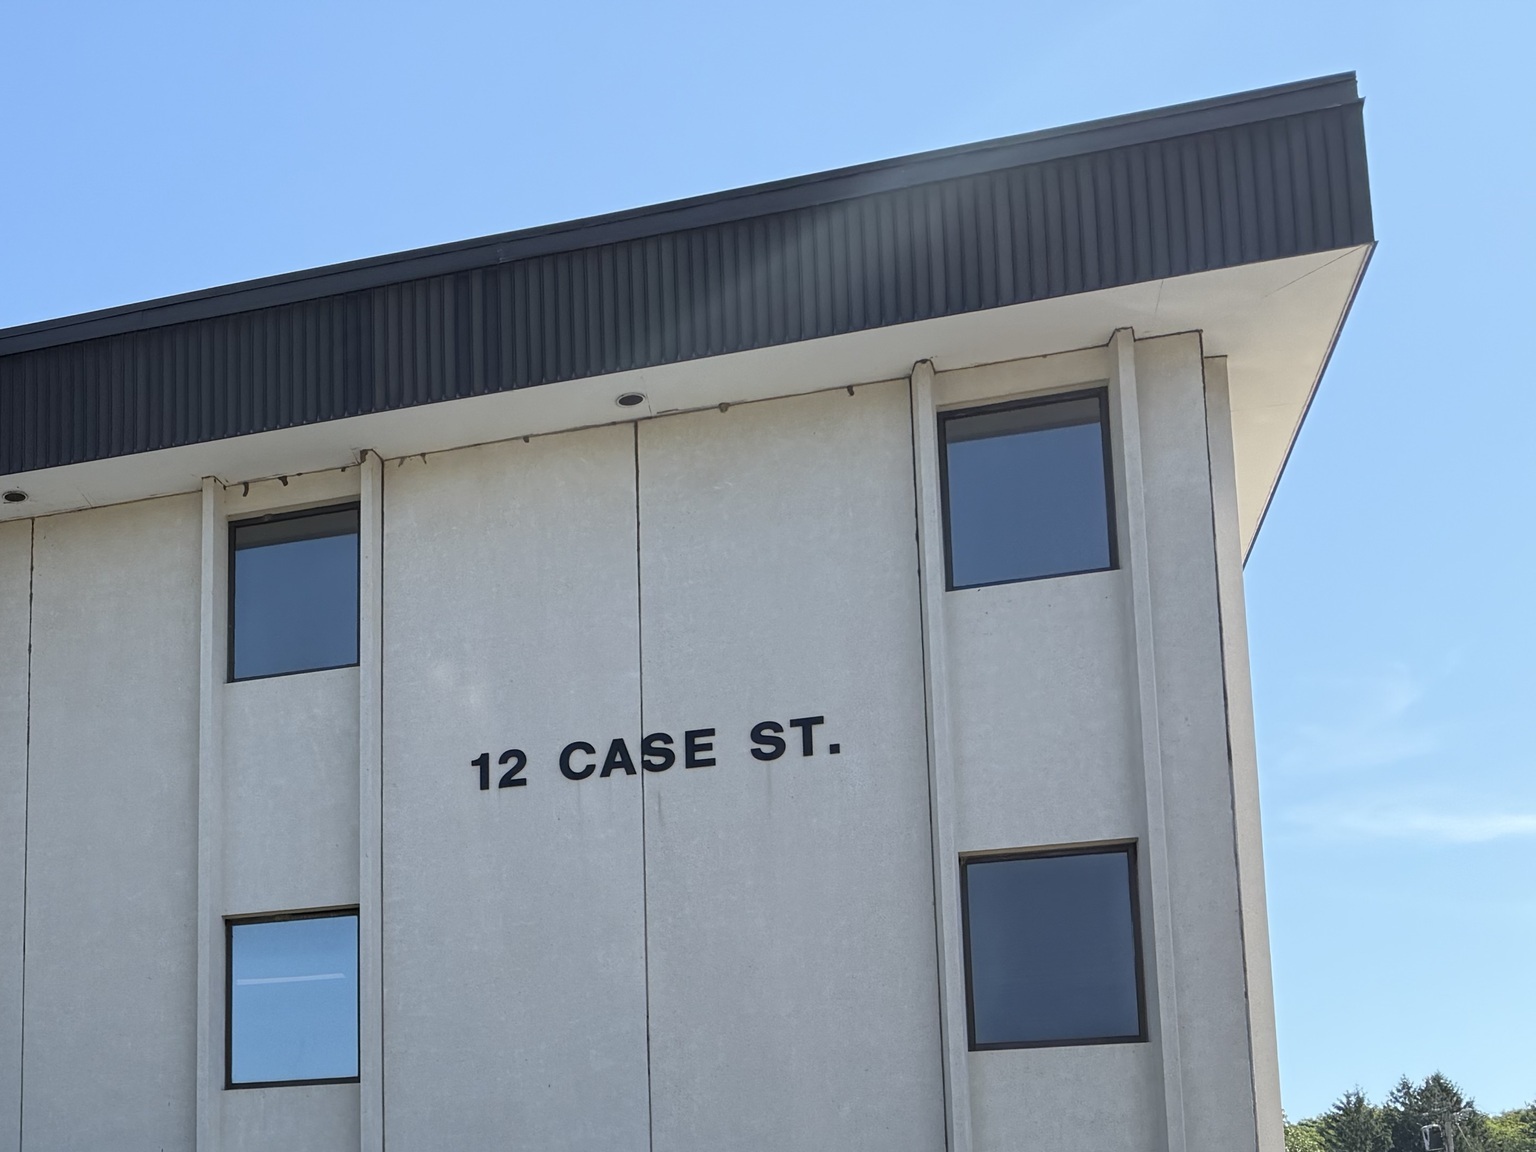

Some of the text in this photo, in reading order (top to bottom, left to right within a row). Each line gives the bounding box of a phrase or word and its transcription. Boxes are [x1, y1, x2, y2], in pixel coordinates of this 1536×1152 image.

[471, 716, 840, 790] 12 CASE ST.
